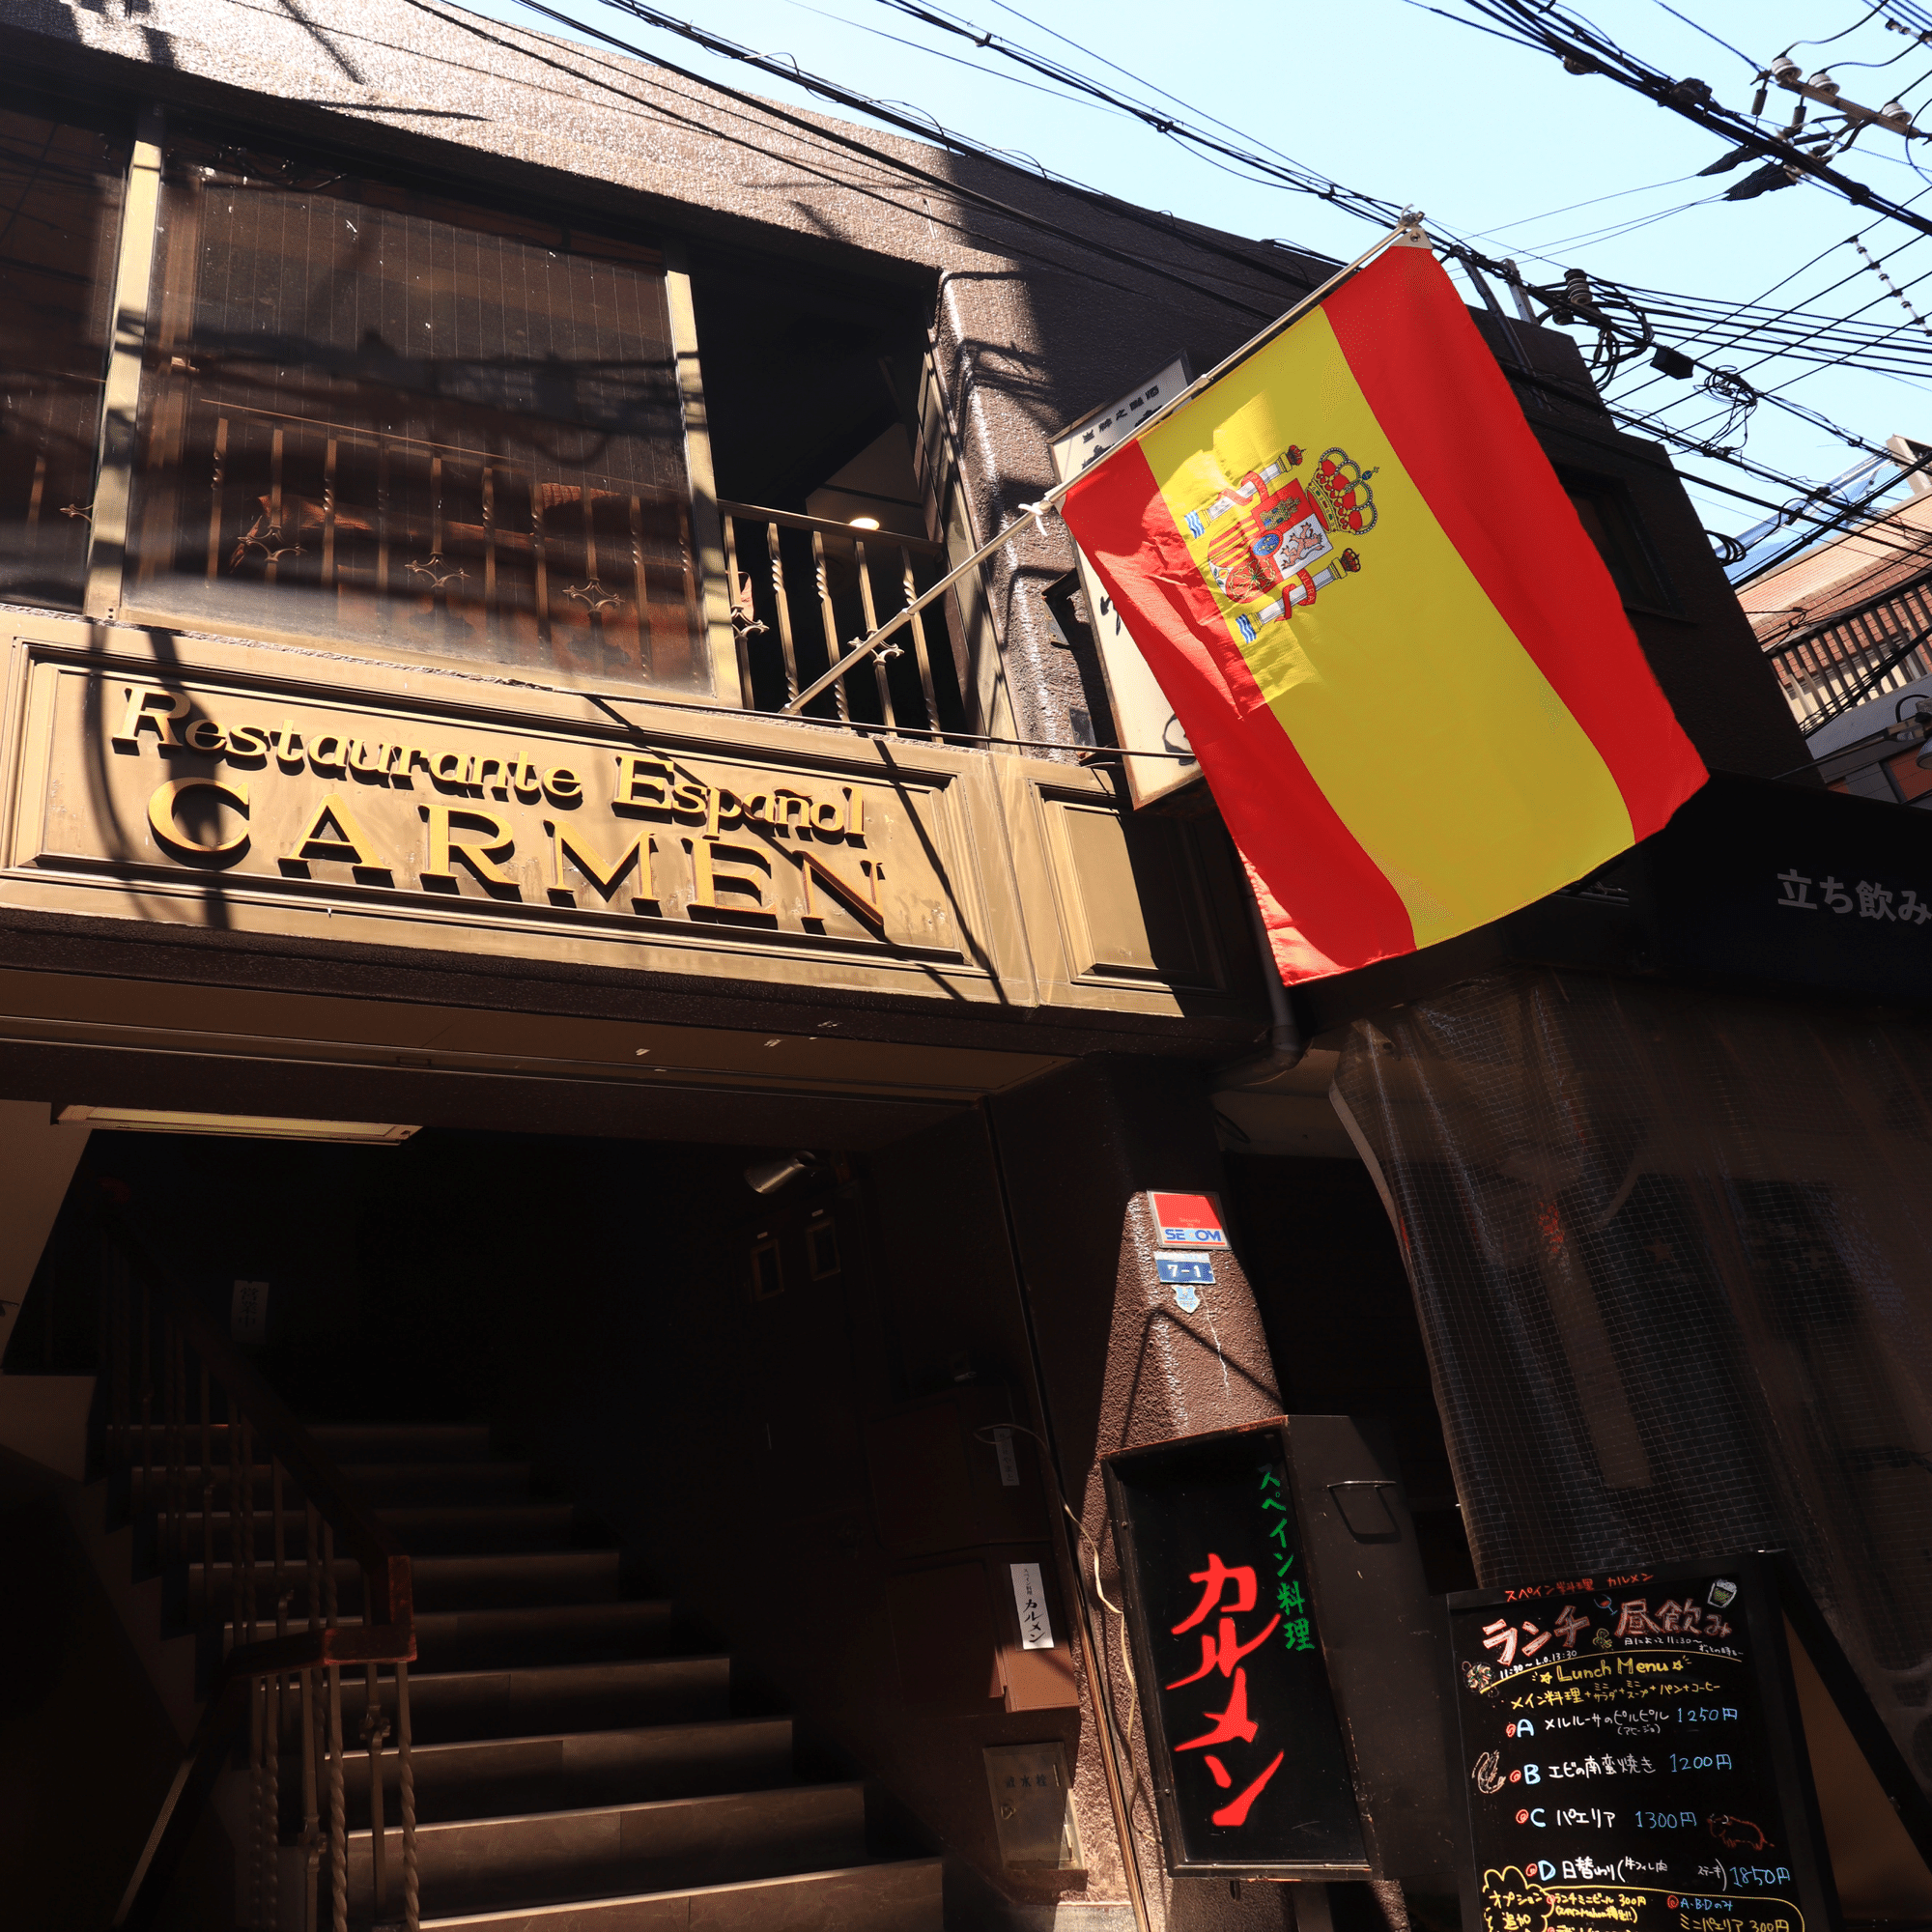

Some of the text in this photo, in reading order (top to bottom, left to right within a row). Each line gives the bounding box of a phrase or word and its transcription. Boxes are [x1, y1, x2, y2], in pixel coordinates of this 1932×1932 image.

[111, 687, 867, 839] Restaurante Español
[148, 778, 884, 926] CARMEN
[1776, 868, 1932, 925] 立ち飲み
[1165, 1229, 1222, 1242] SECOM
[1167, 1264, 1202, 1278] 7-1
[1259, 1463, 1315, 1652] スペイン料理
[1504, 1573, 1655, 1603] スペイン料理 カルメン
[1023, 1599, 1046, 1643] カルメン
[1483, 1605, 1591, 1666] ランチ
[1614, 1599, 1733, 1638] 昼飲み
[1556, 1657, 1669, 1683] Lunch Menu
[1166, 1553, 1285, 1827] カルメン
[1516, 1719, 1535, 1738] A
[1523, 1763, 1542, 1785] B
[1548, 1752, 1657, 1779] エビの南蛮焼き
[1530, 1807, 1697, 1830] C パエリア 1300円
[1537, 1861, 1556, 1882] D
[1489, 1889, 1543, 1910] オプション
[1618, 1892, 1647, 1908] 300円
[1501, 1911, 1532, 1931] 追加
[1680, 1913, 1744, 1932] ミニパエリア
